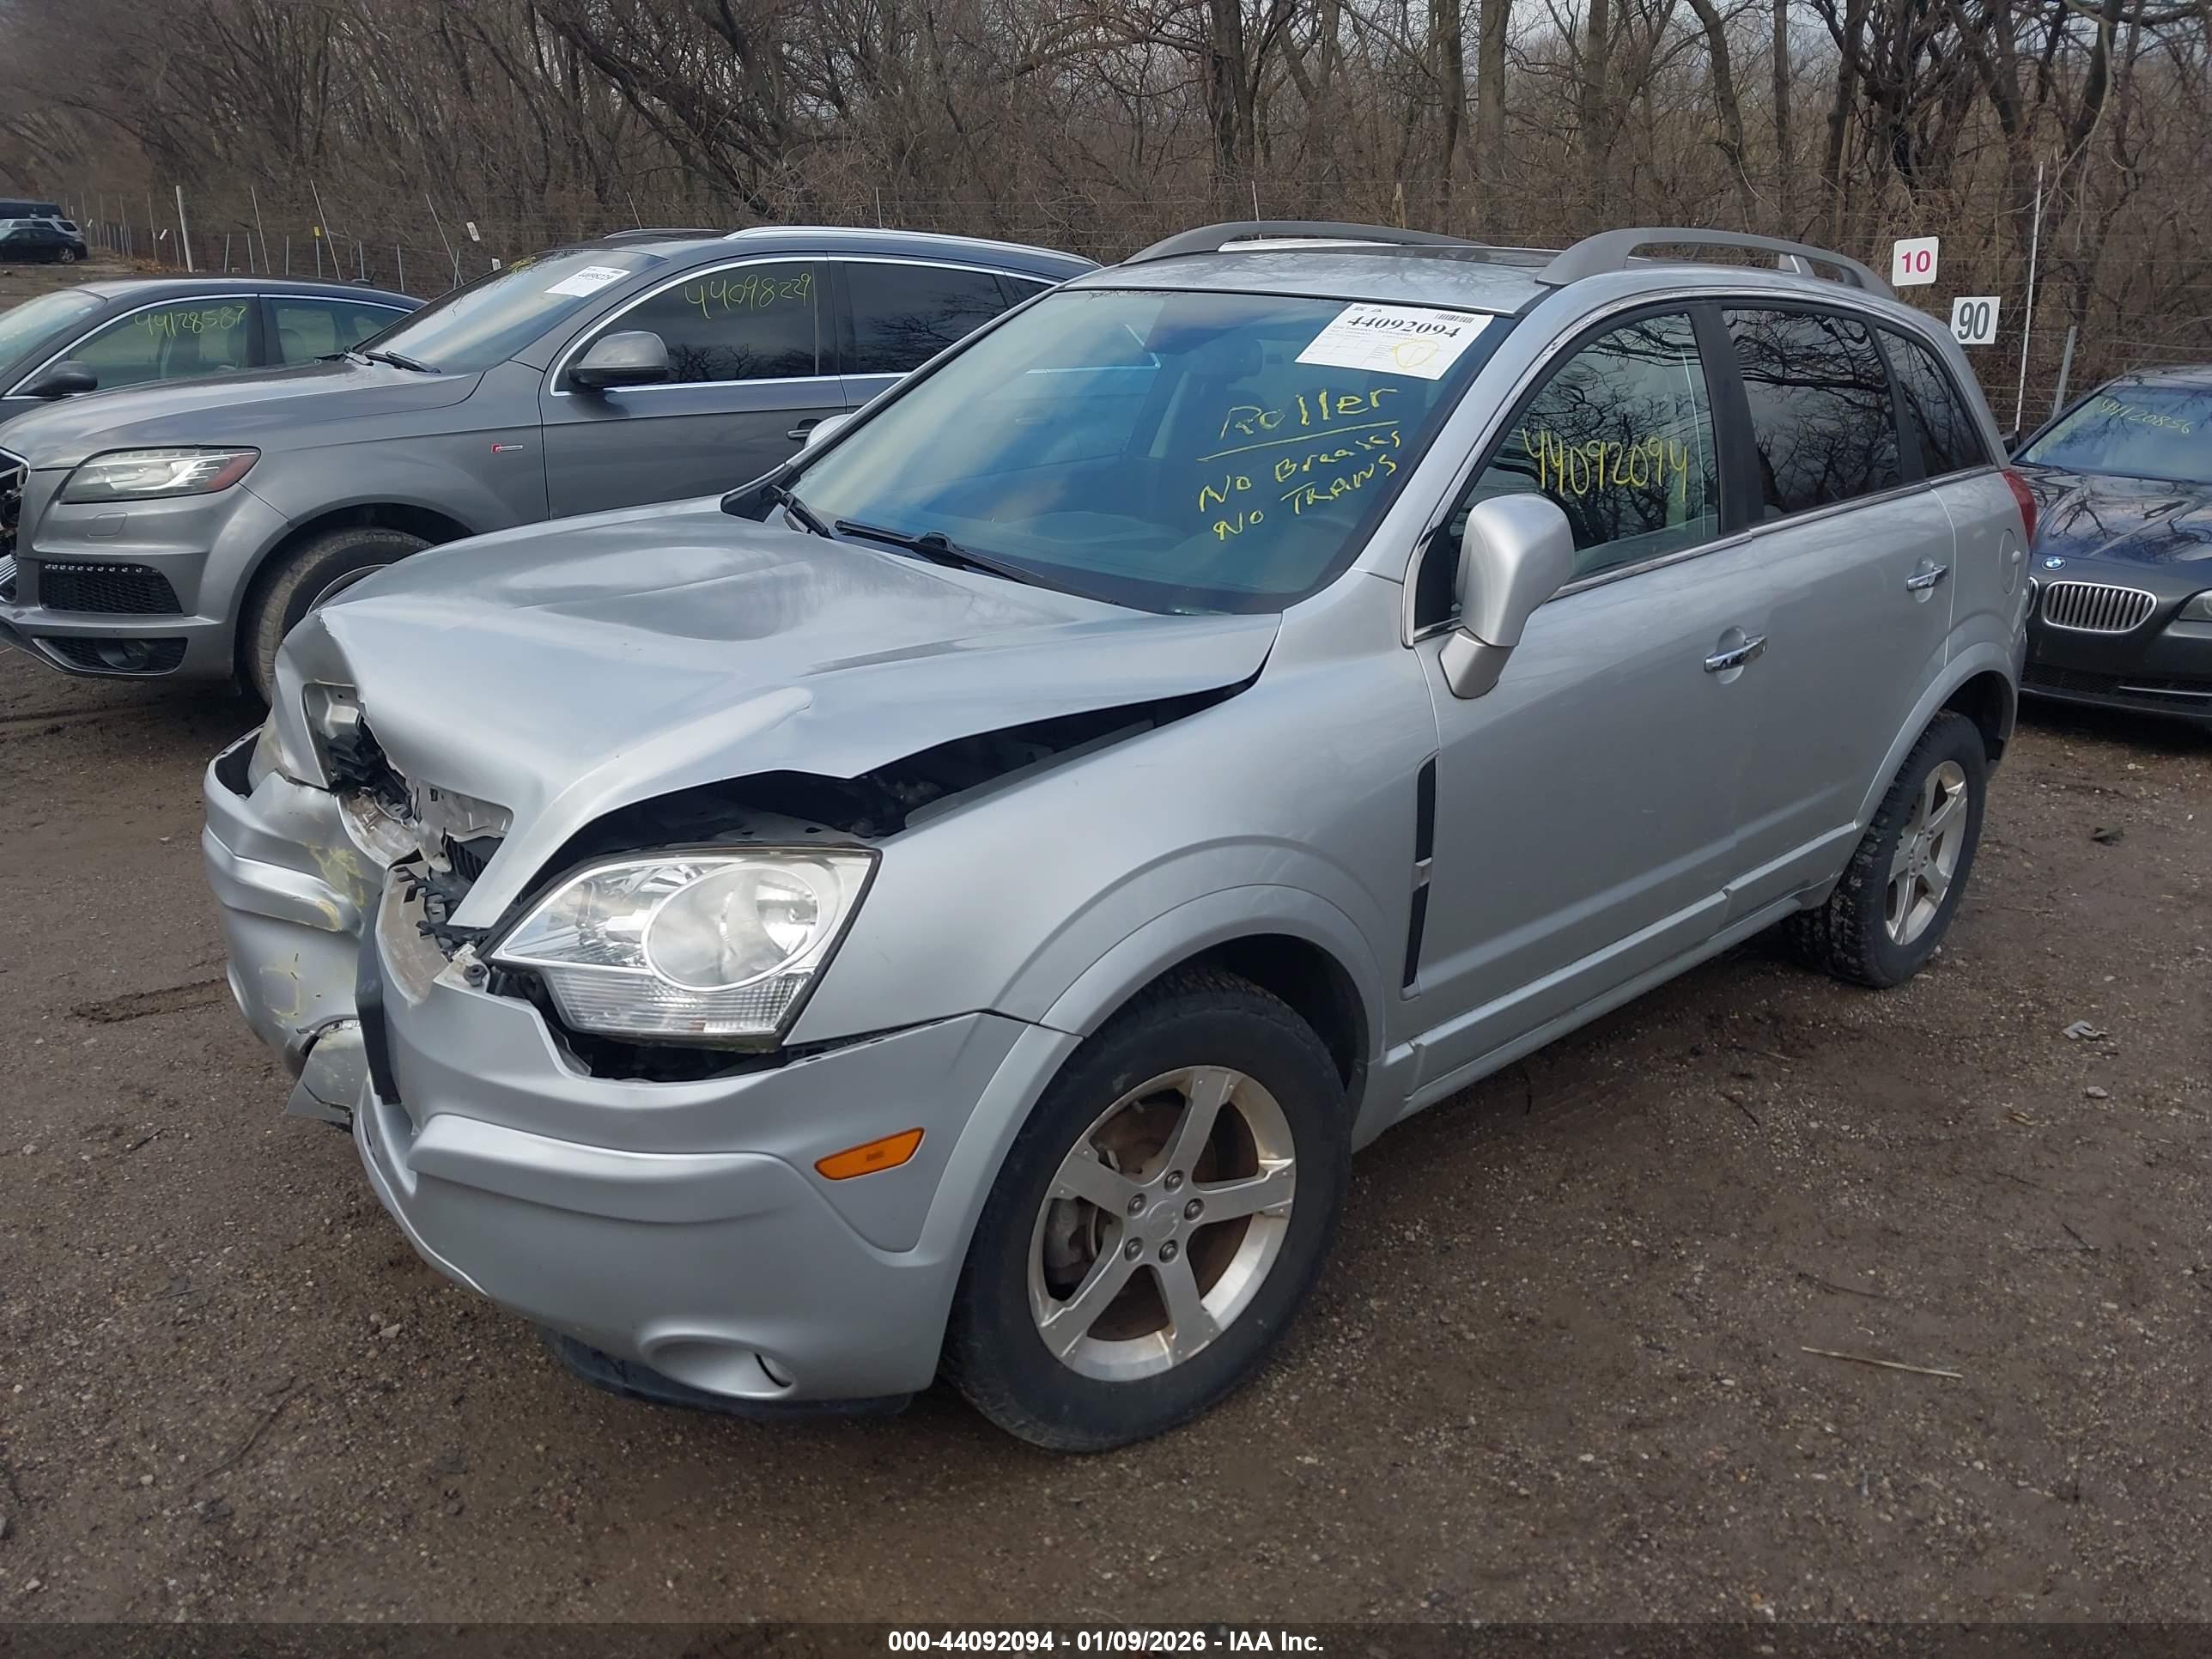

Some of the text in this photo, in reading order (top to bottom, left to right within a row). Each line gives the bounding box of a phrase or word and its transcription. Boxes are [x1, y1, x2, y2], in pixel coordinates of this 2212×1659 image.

[1901, 250, 1931, 274] 10
[684, 273, 811, 319] 44098229
[135, 306, 246, 337] 44128587
[1347, 315, 1462, 338] 44092094
[1958, 301, 1990, 340] 90
[1522, 428, 1687, 501] 44092094
